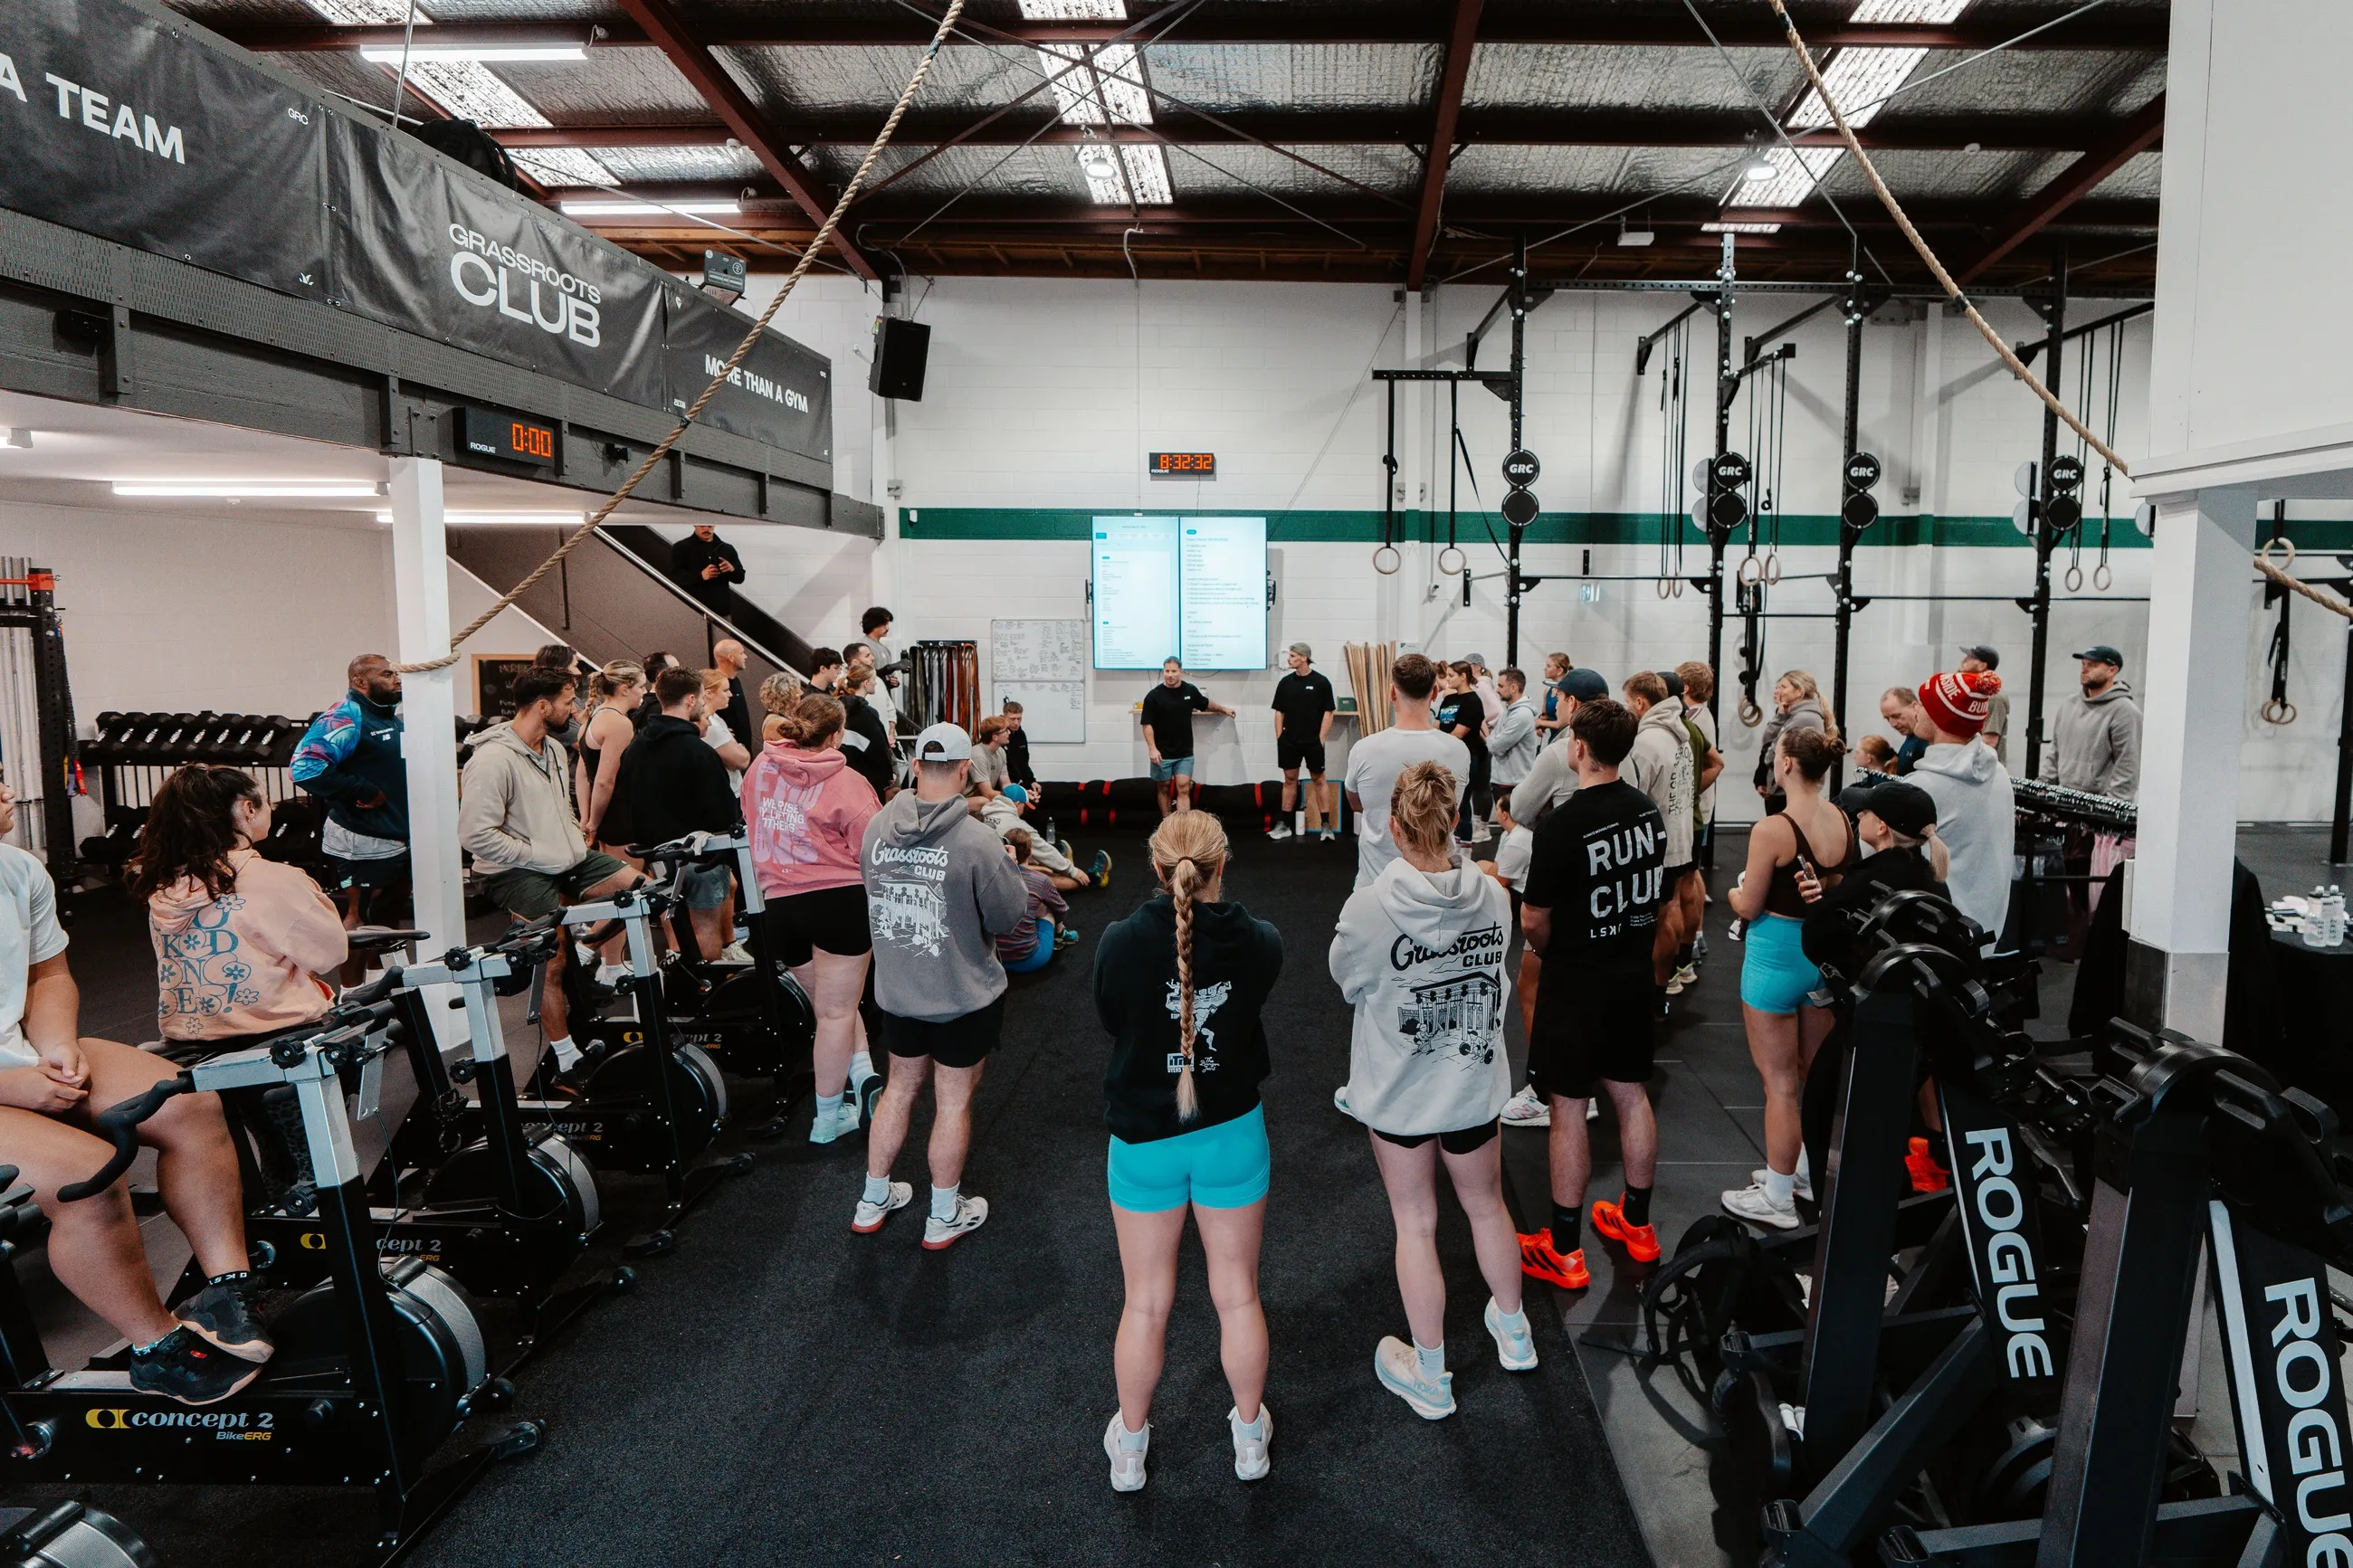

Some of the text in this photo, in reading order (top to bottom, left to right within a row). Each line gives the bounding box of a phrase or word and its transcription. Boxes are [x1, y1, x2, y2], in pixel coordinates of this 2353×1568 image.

[0, 52, 186, 165] A TEAM
[288, 107, 309, 126] GRC
[448, 223, 602, 305] GRASSROOTS
[450, 251, 601, 348] CLUB
[744, 369, 774, 400] THAN
[776, 385, 784, 404] A
[785, 388, 809, 413] GYM
[471, 442, 496, 454] ROGUE
[511, 422, 552, 458] 0:00
[1159, 454, 1213, 470] 8:32:32
[1509, 463, 1534, 474] GRC
[1719, 466, 1743, 476] GRC
[1850, 467, 1874, 478] GRC
[2053, 469, 2078, 480] GRC
[777, 800, 799, 814] RISE
[770, 810, 805, 824] LIFTING
[871, 837, 949, 866] Grassroots
[914, 865, 947, 881] CLUB
[1390, 920, 1504, 971] Grasroots
[1462, 950, 1502, 968] CLUB
[593, 1122, 604, 1133] 2
[376, 1238, 442, 1252] cept 2
[1964, 1126, 2054, 1379] ROGUE
[131, 1411, 274, 1430] concept 2
[2263, 1277, 2353, 1568] ROGUE
[215, 1431, 272, 1440] BikeERG
